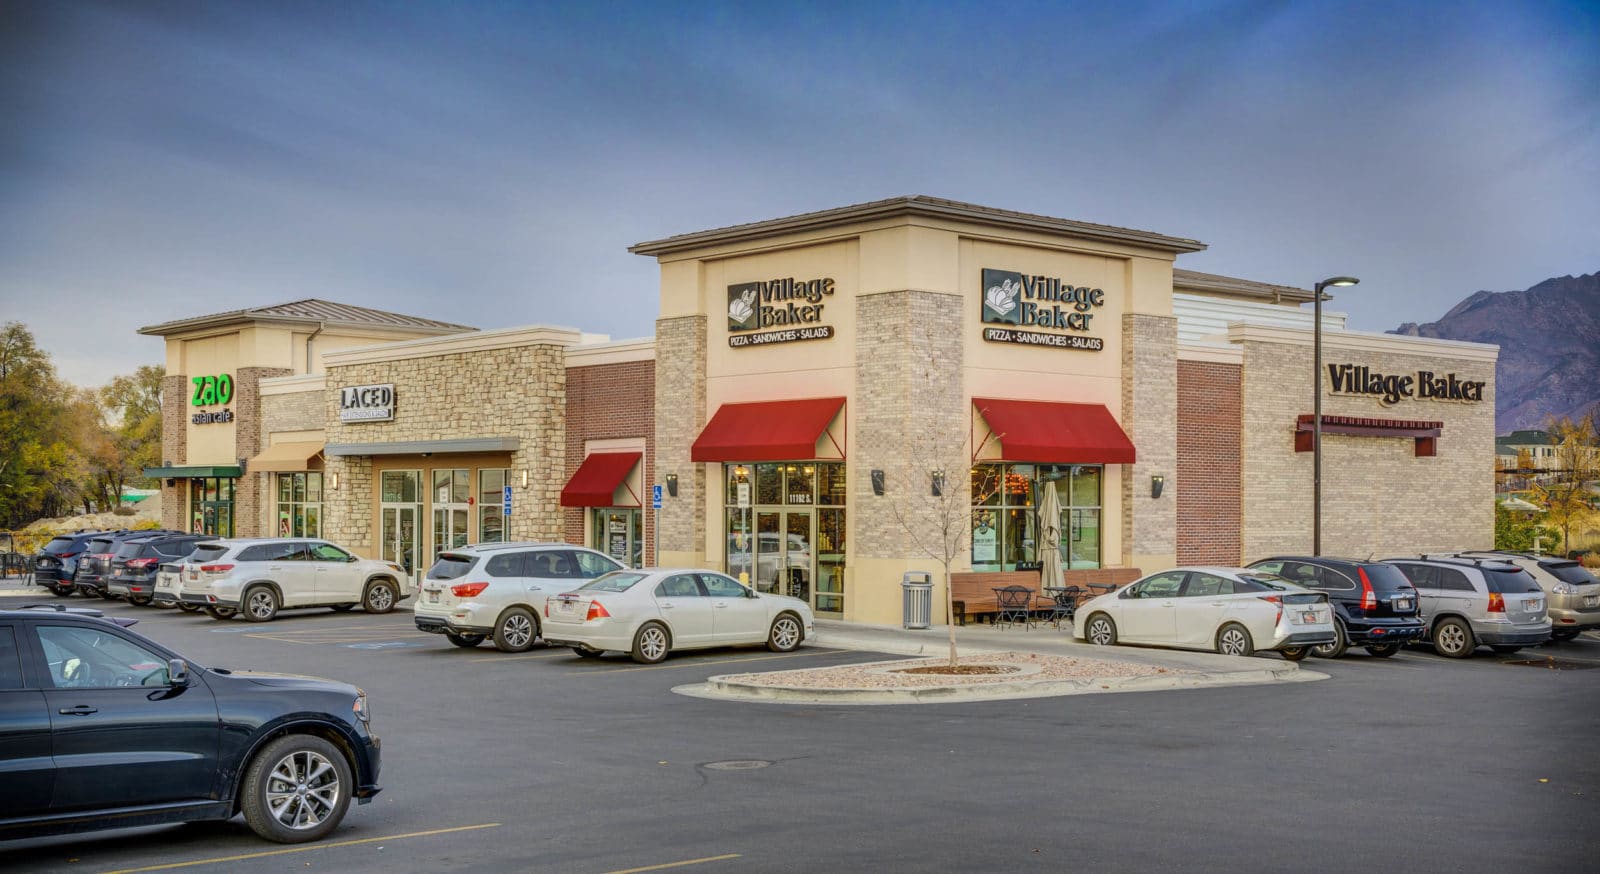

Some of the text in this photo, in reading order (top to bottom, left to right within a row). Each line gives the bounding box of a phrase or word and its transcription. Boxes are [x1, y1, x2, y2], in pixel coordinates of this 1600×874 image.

[760, 277, 835, 303] Village
[1021, 274, 1104, 312] Village
[760, 303, 824, 328] Baker
[1021, 302, 1094, 331] Baker
[730, 327, 829, 346] PIZZA SANDWICHES SALADS
[989, 329, 1101, 350] PIZZA SANDWICHES SALADS
[192, 373, 233, 406] zao
[1328, 363, 1486, 404] Village Baker
[341, 386, 391, 409] LACED
[192, 409, 212, 424] asian
